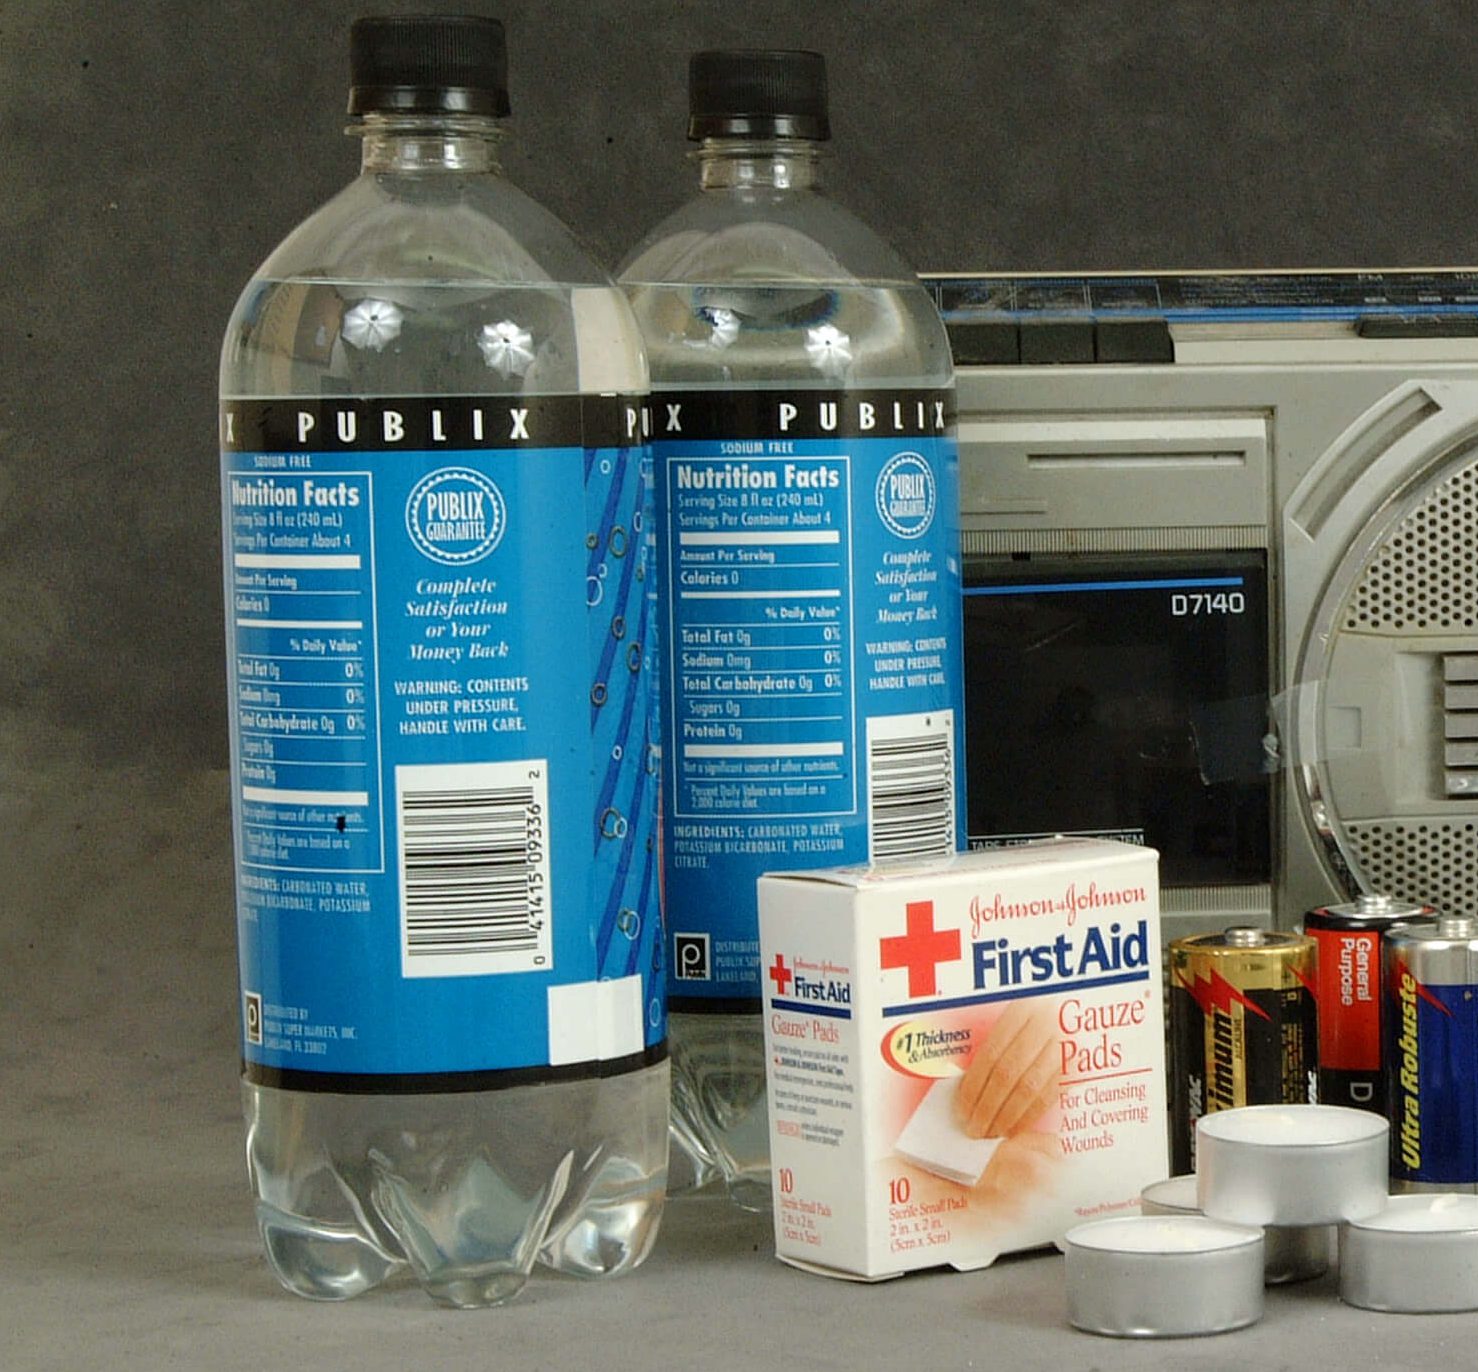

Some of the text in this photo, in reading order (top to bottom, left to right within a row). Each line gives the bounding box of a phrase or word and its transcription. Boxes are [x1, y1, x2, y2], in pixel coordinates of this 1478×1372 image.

[297, 408, 531, 443] PUBLIX
[666, 402, 945, 432] X PUBLIX
[720, 441, 794, 454] SODIUM FREE
[677, 463, 840, 489] Nutrition Facts
[890, 474, 925, 499] PUBLIX
[303, 480, 360, 506] Facts
[679, 494, 716, 510] Serving
[718, 493, 738, 507] Size
[776, 492, 800, 508] (240
[803, 492, 824, 507] mL)
[427, 490, 485, 520] PUBLIX
[679, 510, 831, 529] Servings Per Container About 4
[426, 521, 487, 541] GUARANTEE
[680, 550, 775, 564] Amount Per Serving
[416, 576, 496, 598] Complete
[680, 570, 728, 585] Calories
[405, 599, 508, 620] Satisfaction
[780, 607, 805, 620] Daily
[1171, 593, 1245, 616] D7140
[425, 621, 491, 638] or Your
[682, 627, 841, 645] Total Fat 0g 0%
[407, 641, 509, 664] Money Back
[682, 650, 841, 670] Sodium 0mg 0%
[394, 677, 529, 695] WARNING: CONTENTS
[682, 673, 842, 693] Total Carbohydrate 0g 0%
[406, 700, 449, 715] UNDER
[689, 700, 741, 717] Sugars 0g
[400, 717, 527, 735] HANDLE WITH CARE.
[684, 723, 742, 740] Protein 0g
[526, 803, 543, 864] 09336
[674, 823, 844, 838] INGREDIENTS: CARBONATED WATER,
[674, 840, 721, 853] POTASSIUM
[793, 838, 844, 851] POTASSIUM
[529, 873, 544, 931] 41415
[971, 919, 1150, 991] First Aid
[1338, 938, 1356, 1006] Purpose
[1357, 938, 1372, 1002] General
[794, 976, 851, 1004] First Aid
[812, 1020, 840, 1044] Pads
[915, 1028, 972, 1047] Thickness
[908, 1043, 973, 1064] & Absorbency
[1059, 1034, 1123, 1076] Pads
[1400, 973, 1421, 1170] Ultra Robuste
[1059, 1081, 1146, 1110] For Cleansing
[1350, 1082, 1373, 1101] D
[1059, 1103, 1149, 1132] And Covering
[1060, 1134, 1114, 1155] Wounds
[779, 1167, 794, 1194] 10
[889, 1177, 911, 1205] 10
[889, 1194, 969, 1221] Sterile Small Pads
[889, 1223, 897, 1237] 2
[922, 1217, 930, 1231] 2
